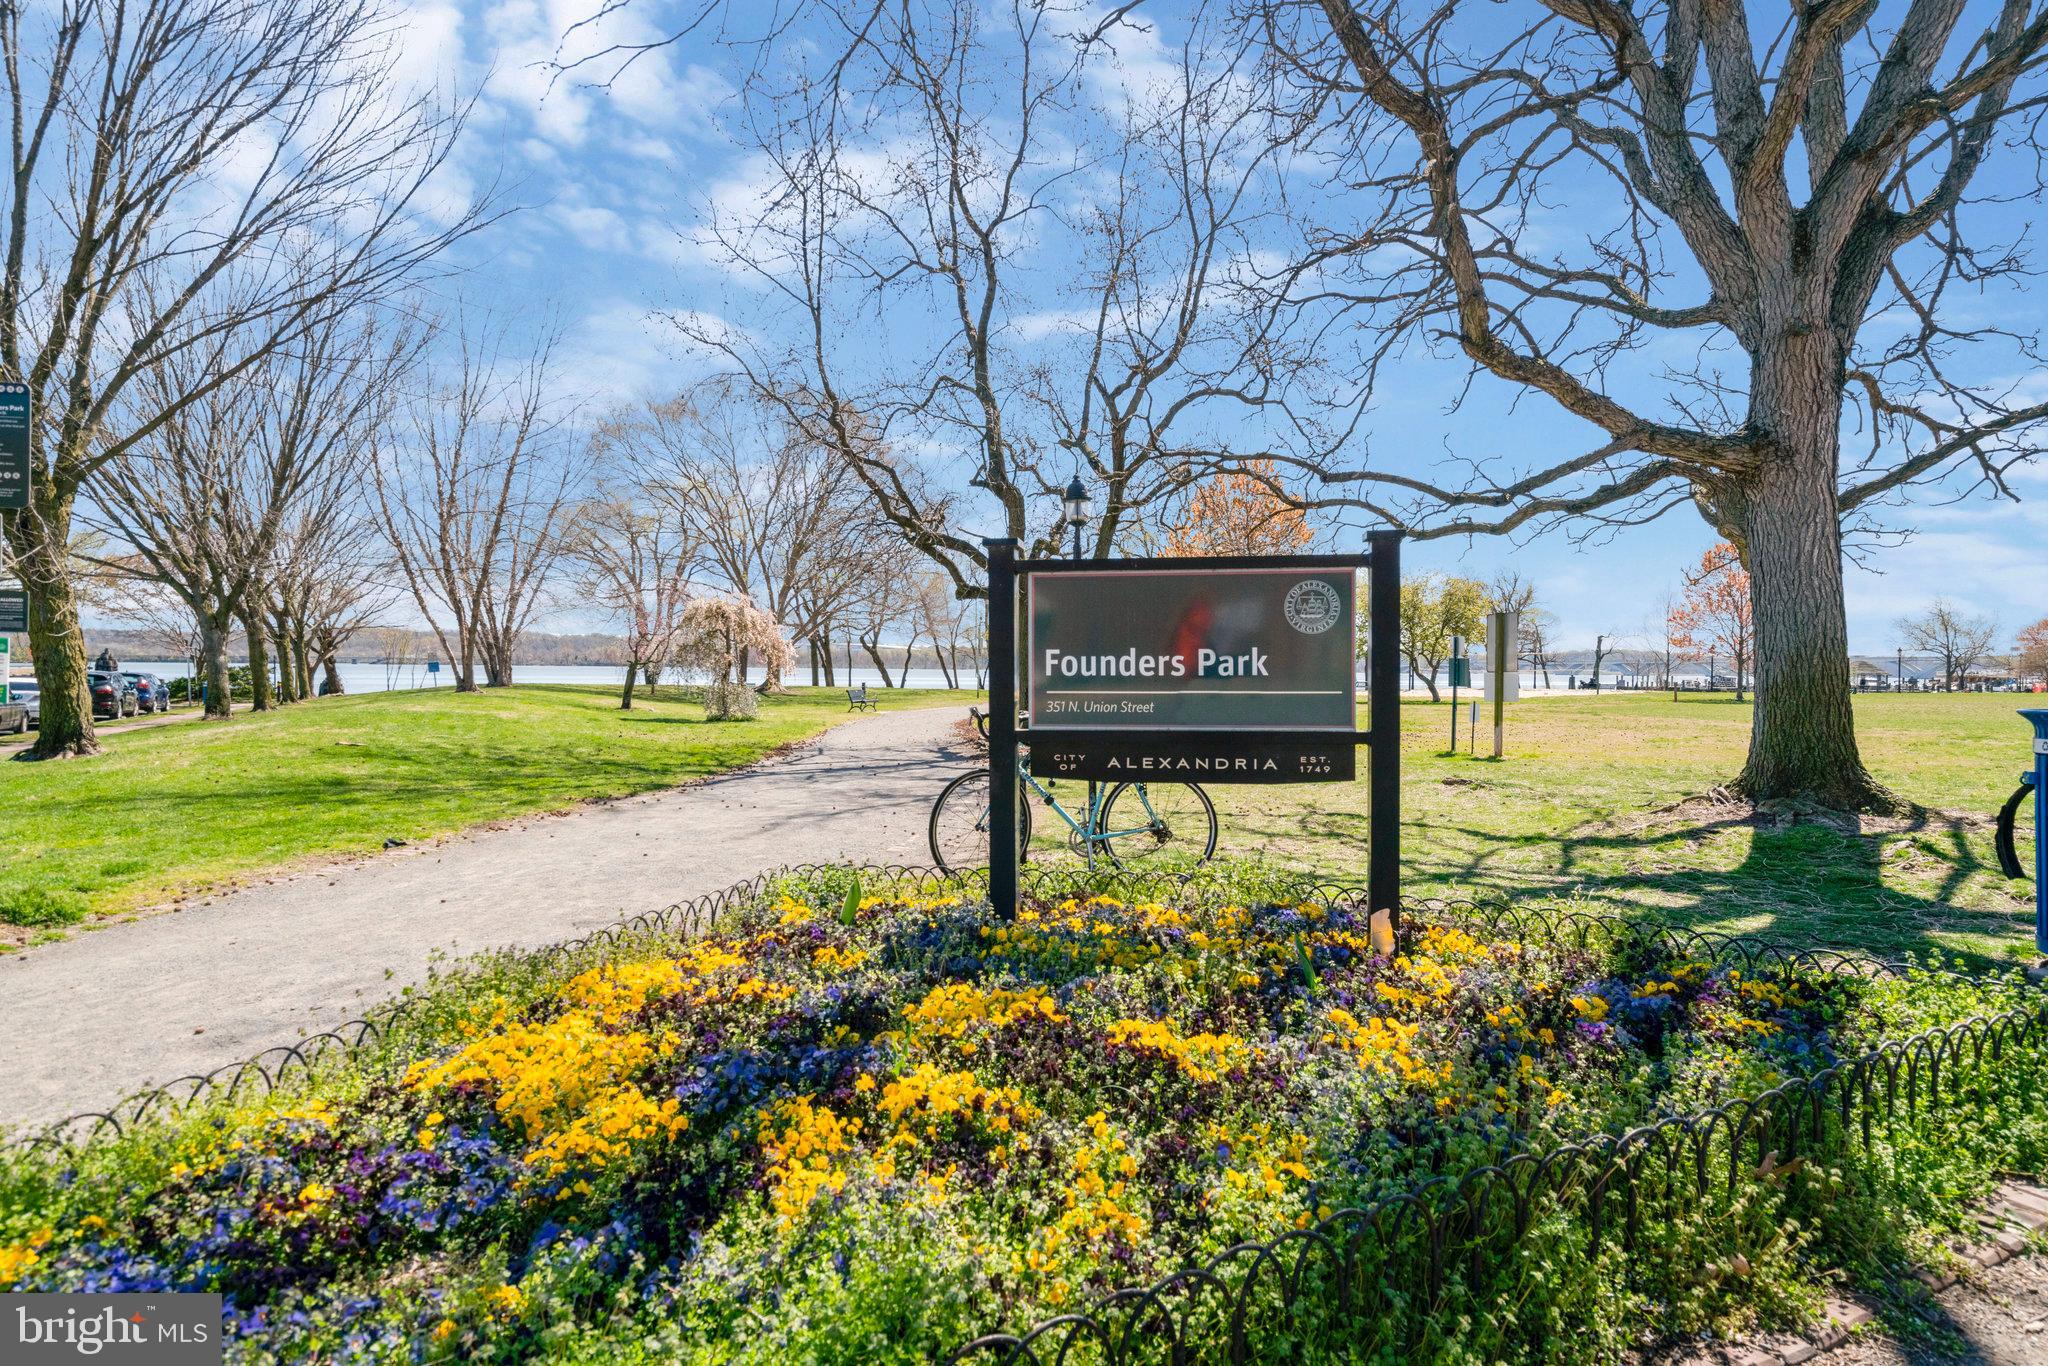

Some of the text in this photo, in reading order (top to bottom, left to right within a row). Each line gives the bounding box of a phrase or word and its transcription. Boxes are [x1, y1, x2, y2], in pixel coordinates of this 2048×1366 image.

[1291, 616, 1336, 632] VIRGINIA
[1045, 647, 1269, 677] Founders Park
[1046, 701, 1155, 713] 351 N. Union Street
[1107, 757, 1278, 770] ALEXANDRIA
[1300, 756, 1331, 764] EST.
[1059, 763, 1077, 771] OF
[1300, 765, 1331, 773] 1749
